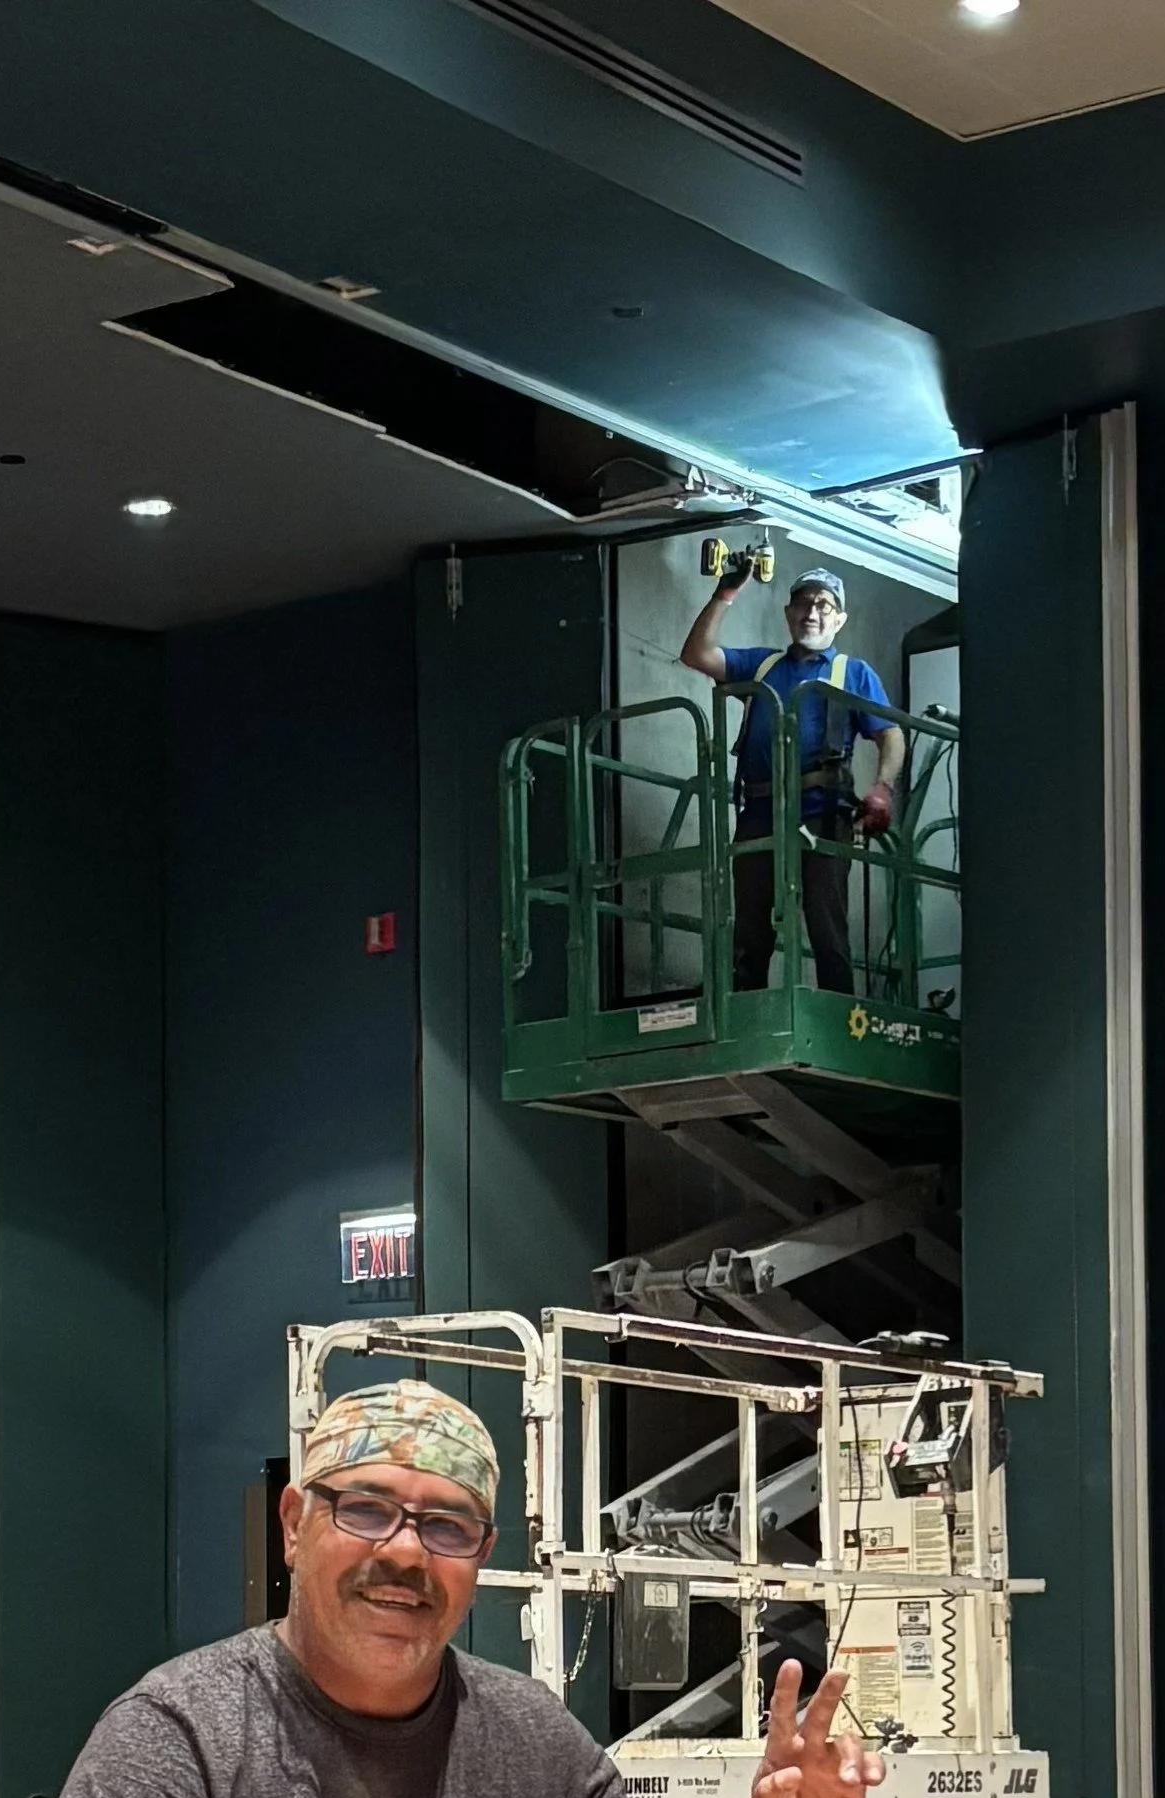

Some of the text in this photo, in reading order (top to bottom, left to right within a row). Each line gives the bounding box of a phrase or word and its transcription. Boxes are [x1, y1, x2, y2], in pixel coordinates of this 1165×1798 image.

[351, 1227, 412, 1279] EXIT
[624, 1776, 669, 1794] UNBELT
[927, 1770, 982, 1793] 2632ES
[1003, 1768, 1038, 1794] JLG
